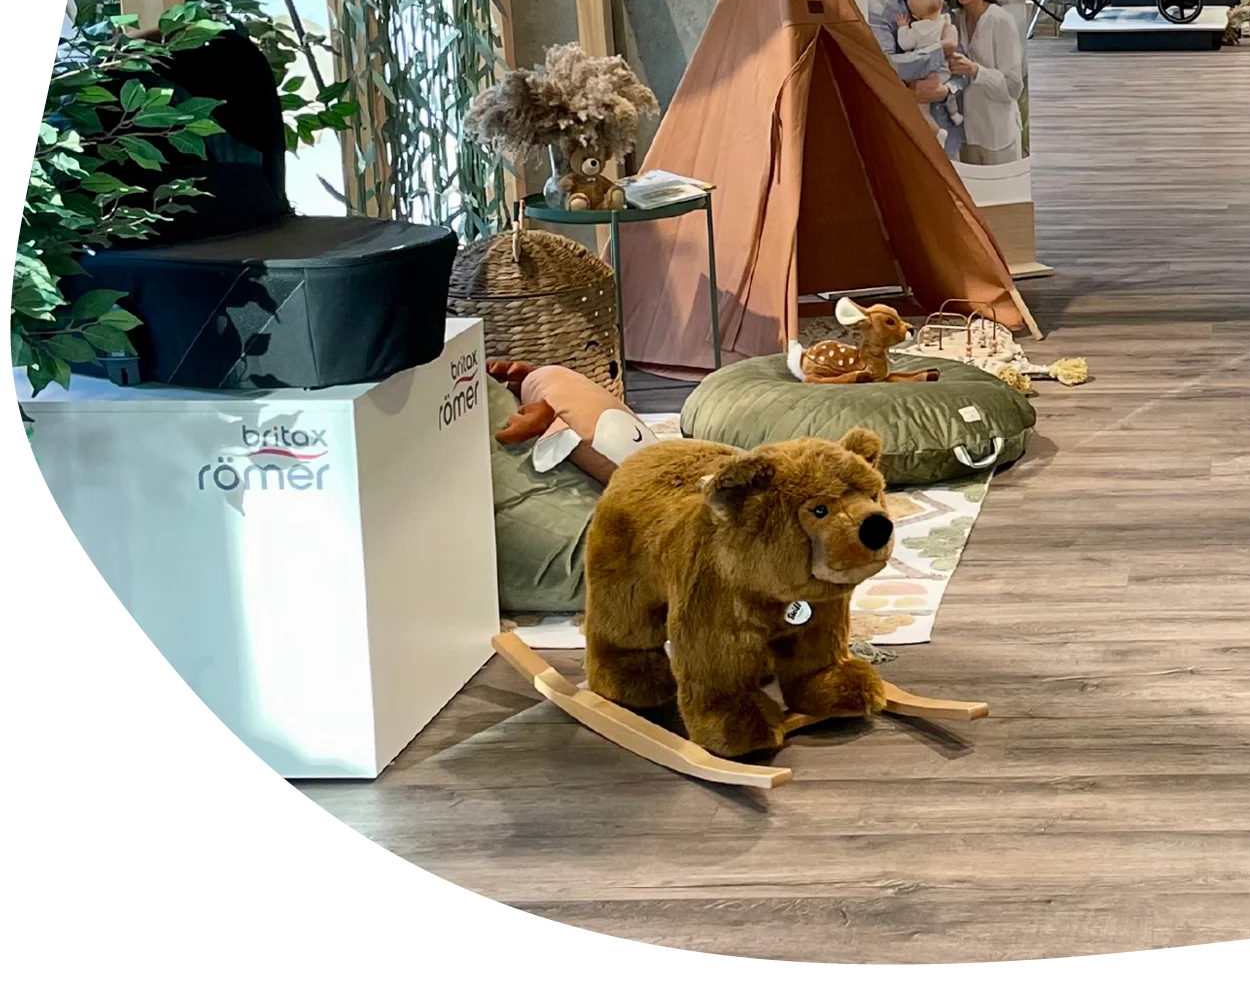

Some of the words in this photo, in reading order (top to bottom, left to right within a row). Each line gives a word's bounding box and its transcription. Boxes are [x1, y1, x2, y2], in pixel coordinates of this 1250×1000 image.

[450, 349, 478, 380] britax
[438, 380, 479, 431] römer
[242, 425, 329, 447] britax
[198, 456, 331, 491] römer
